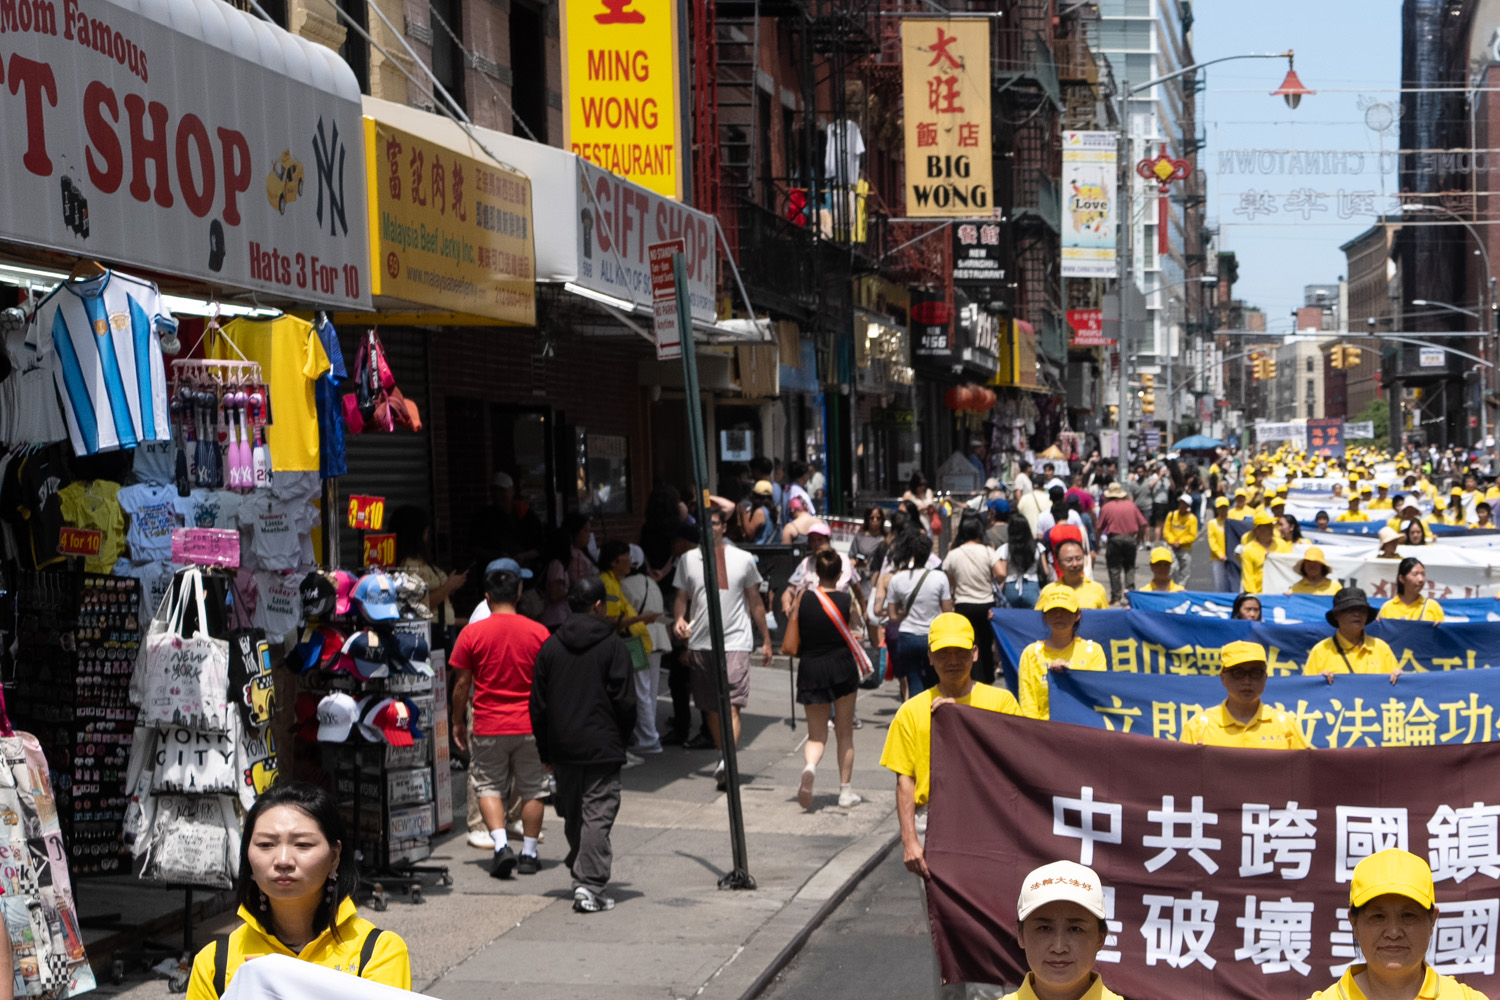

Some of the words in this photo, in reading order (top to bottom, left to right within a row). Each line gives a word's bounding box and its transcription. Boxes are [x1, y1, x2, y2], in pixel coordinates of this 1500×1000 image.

[63, 0, 148, 83] Famous
[588, 49, 650, 82] MING
[928, 27, 965, 115] 大旺
[581, 97, 659, 130] WONG
[916, 121, 981, 148] 飯店
[83, 80, 252, 227] SHOP
[927, 155, 971, 180] BIG
[913, 184, 987, 209] WONG
[1075, 198, 1108, 210] Love
[595, 175, 649, 265] GIFT
[656, 201, 708, 283] SHOP
[382, 211, 419, 252] Malaysia
[420, 222, 438, 254] Beef
[439, 230, 461, 266] Jerky
[462, 234, 476, 265] Inc.
[969, 249, 987, 258] NEW
[249, 241, 291, 286] Hats
[295, 250, 307, 288] 3
[311, 252, 339, 297] For
[342, 262, 361, 299] 10
[601, 259, 614, 283] ALL
[953, 270, 1006, 280] RESTAURANT
[258, 511, 288, 521] Mommy's
[348, 498, 358, 528] 3
[364, 501, 384, 530] $10
[260, 526, 290, 534] Meatball
[264, 520, 284, 528] Little
[60, 532, 67, 547] 4
[70, 533, 84, 548] for
[87, 535, 100, 550] 10
[268, 585, 298, 597] Daddy's
[266, 603, 294, 615] Meatball
[272, 596, 291, 605] Little
[170, 648, 208, 664] NEW
[172, 664, 203, 684] YORK
[158, 728, 234, 745] YORK
[156, 750, 234, 766] CITY
[391, 817, 408, 834] NEW
[1029, 876, 1094, 893] 法輪大法好
